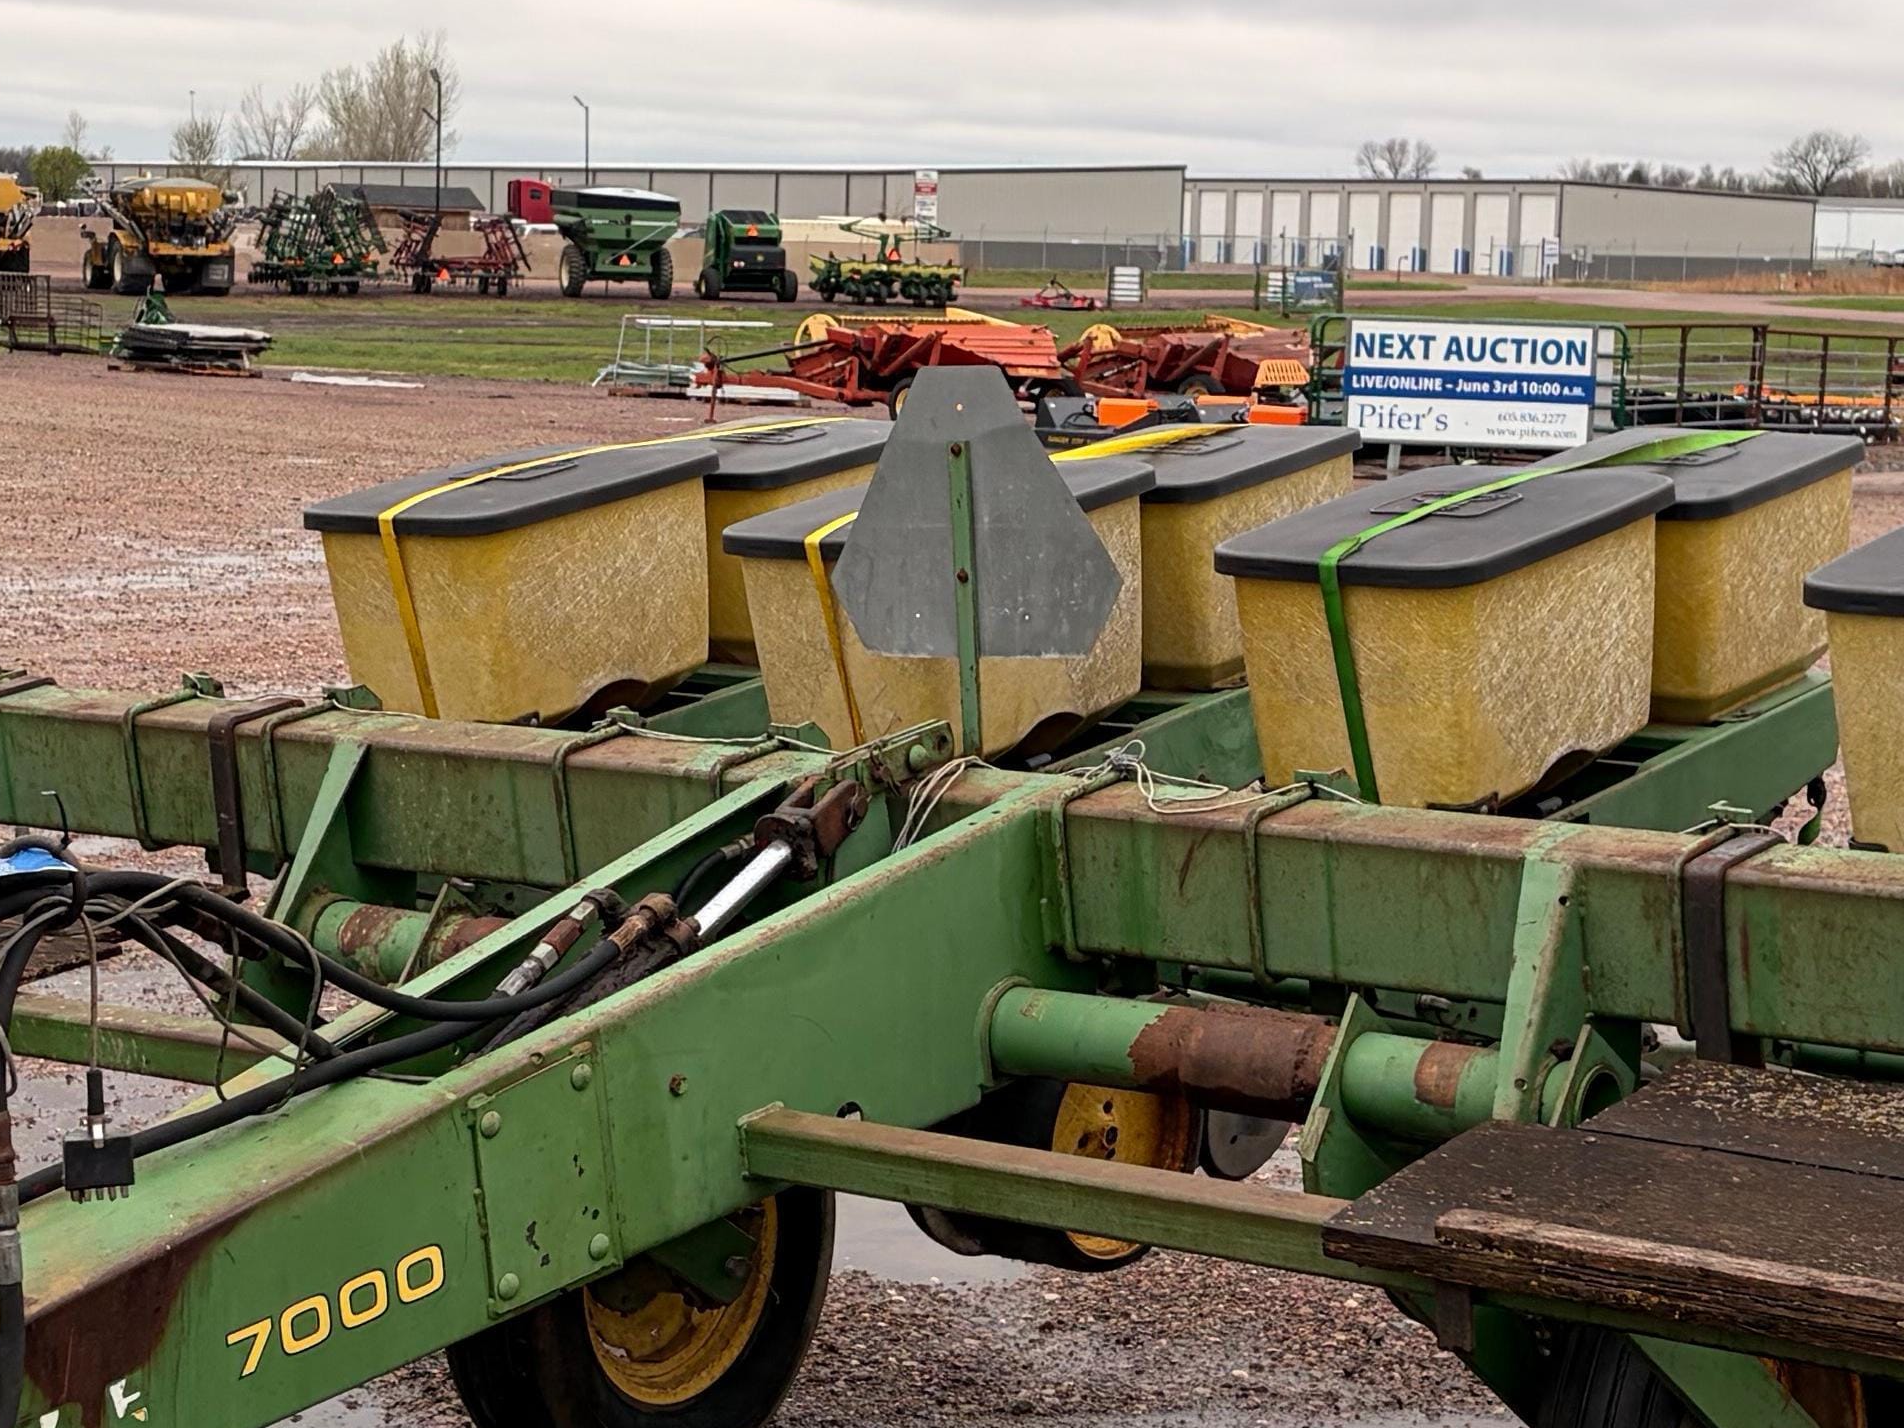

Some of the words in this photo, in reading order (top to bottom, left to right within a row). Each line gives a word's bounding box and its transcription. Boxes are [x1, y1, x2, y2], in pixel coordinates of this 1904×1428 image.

[1354, 332, 1436, 360] NEXT
[1443, 335, 1587, 366] AUCTION
[1352, 374, 1443, 392] LIVE/ONLINE
[1456, 378, 1490, 393] June
[1492, 379, 1518, 395] 3rd
[1521, 381, 1561, 396] 10:00
[225, 1243, 446, 1380] 7000
